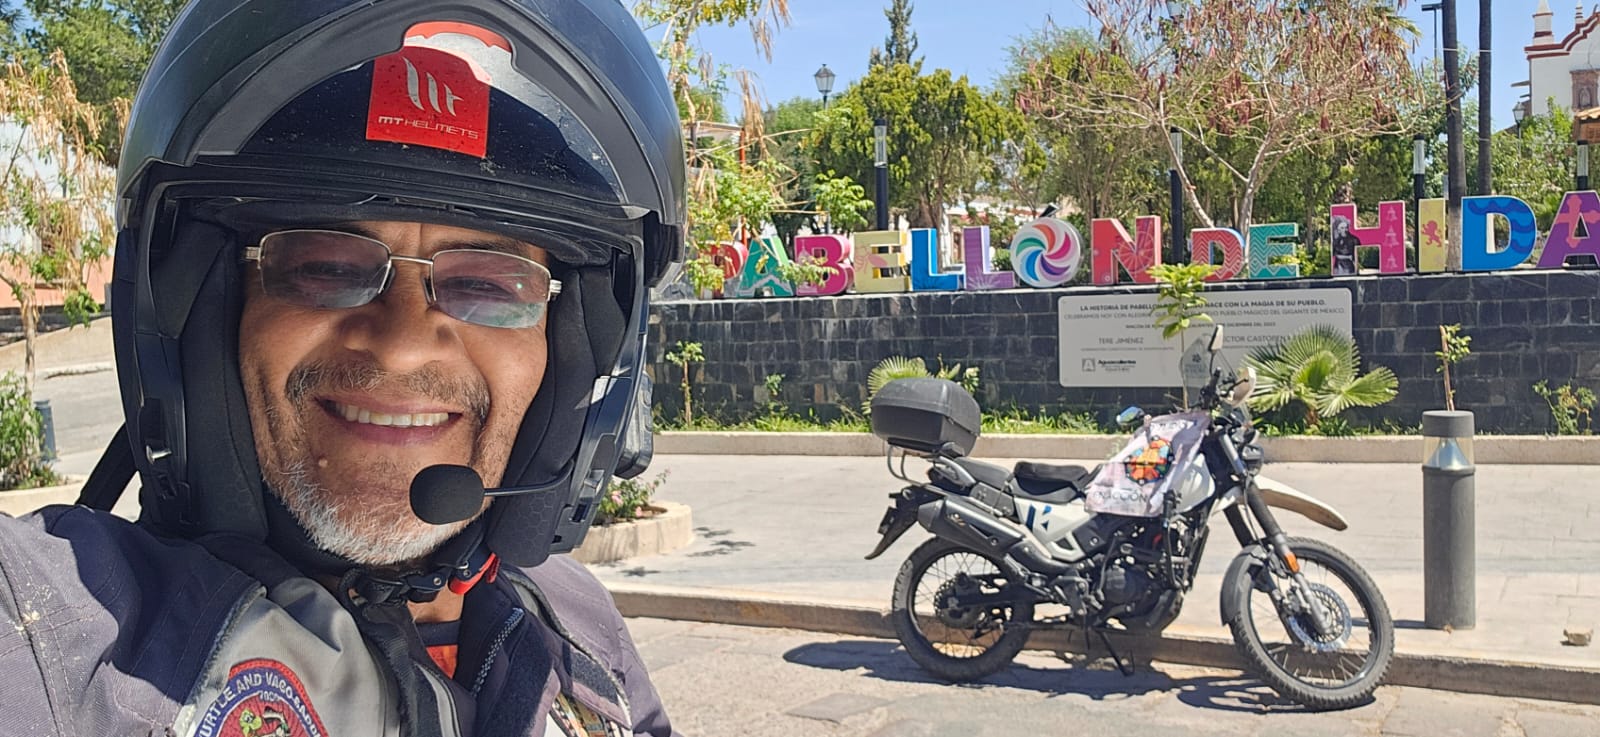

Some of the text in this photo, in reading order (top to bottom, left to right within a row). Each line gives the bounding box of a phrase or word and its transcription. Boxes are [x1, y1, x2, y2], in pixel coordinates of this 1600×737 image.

[378, 116, 479, 140] MT HELMETS
[1190, 222, 1300, 283] DE
[199, 684, 236, 737] URTLE
[235, 673, 262, 693] AND
